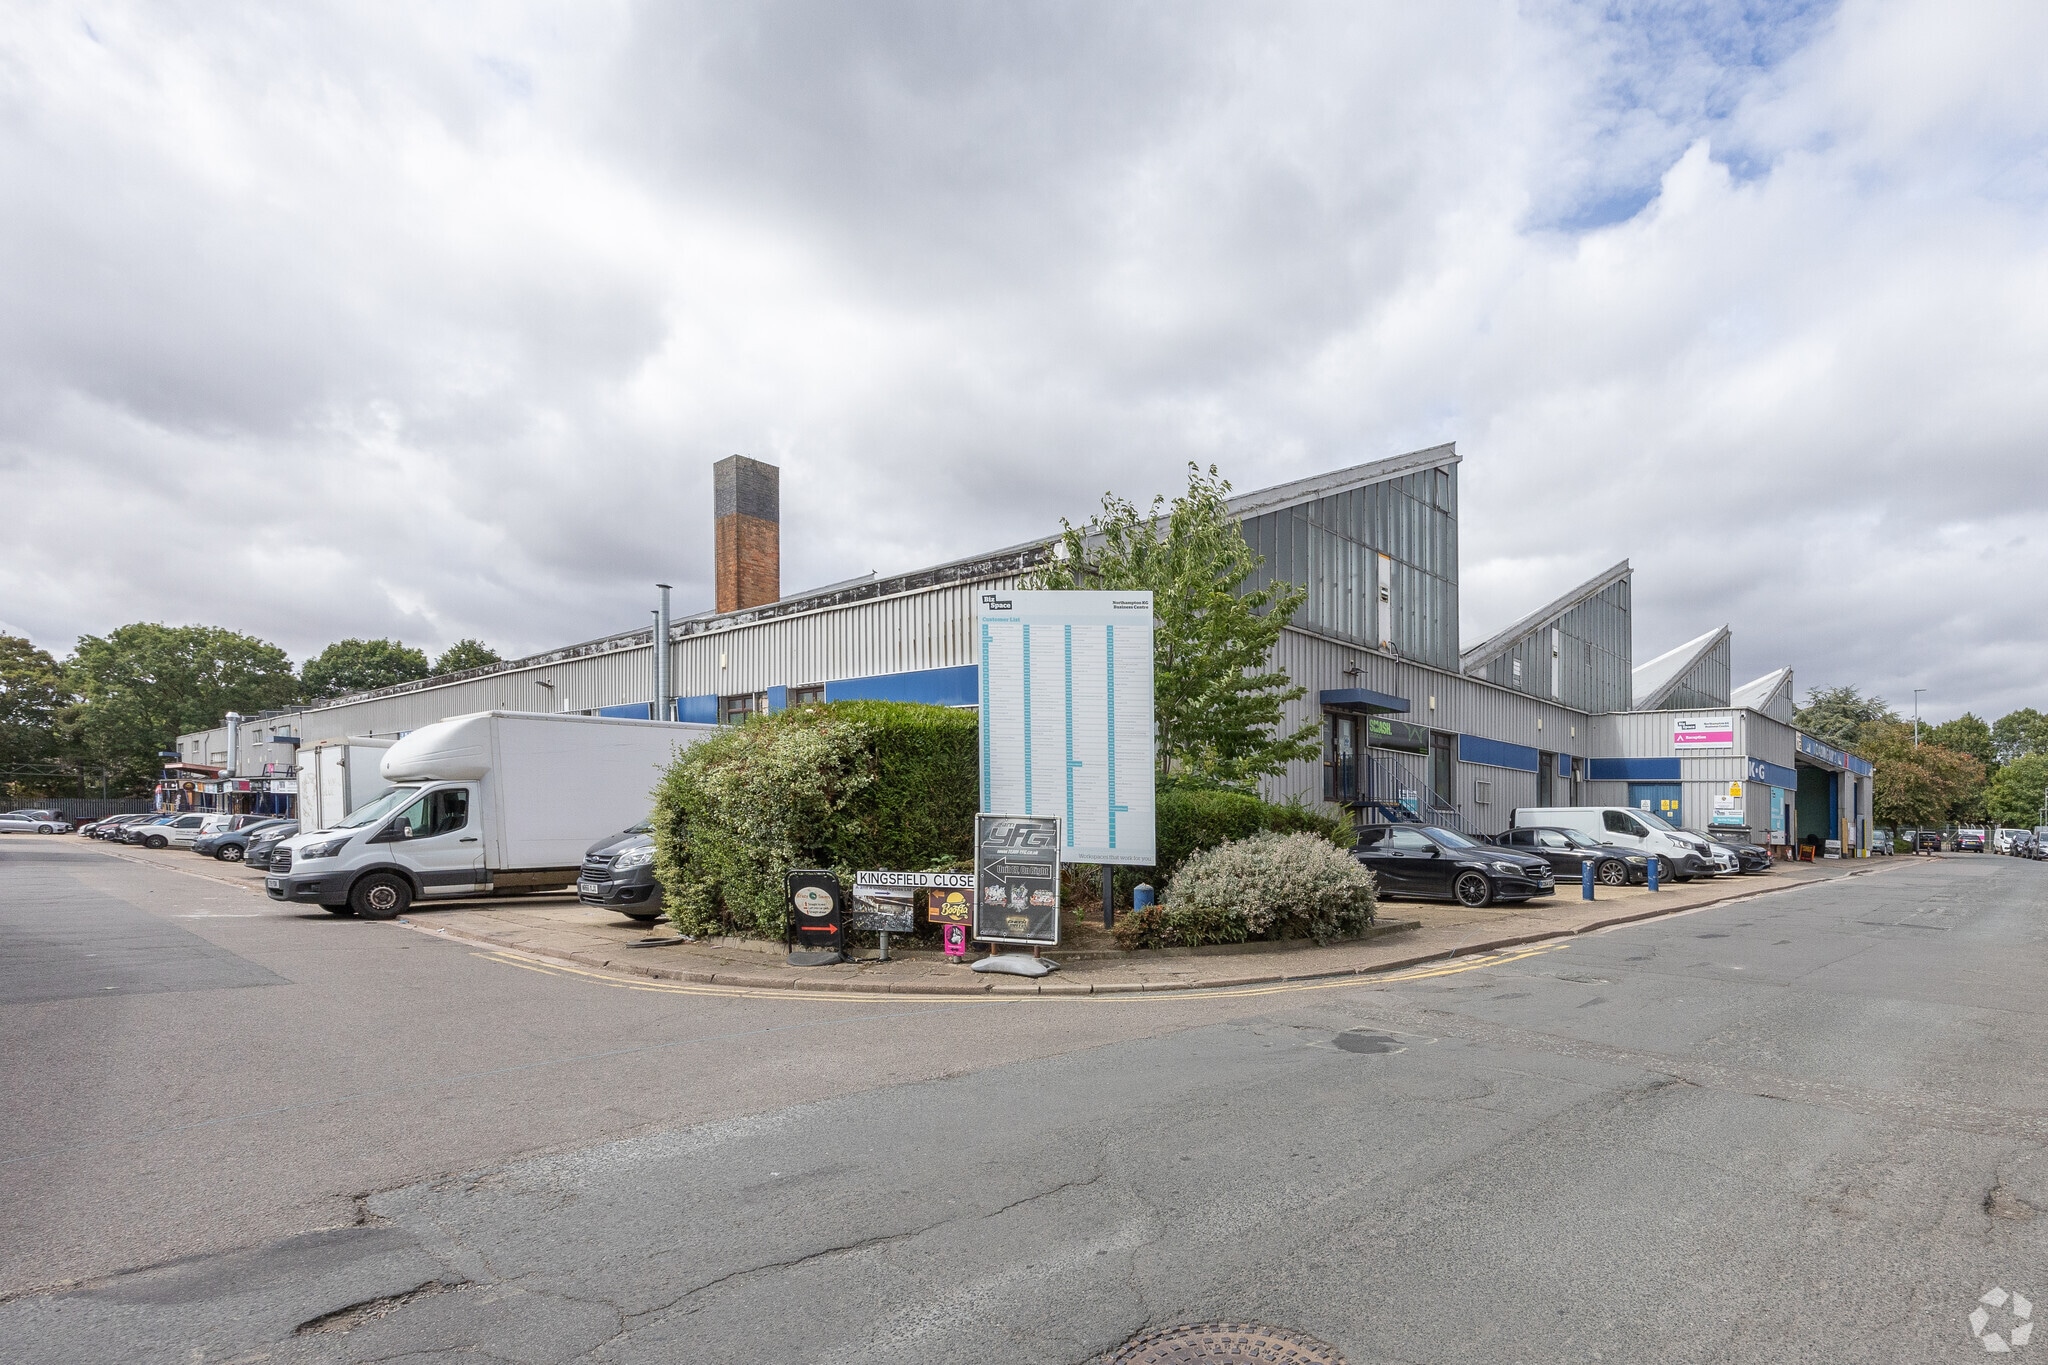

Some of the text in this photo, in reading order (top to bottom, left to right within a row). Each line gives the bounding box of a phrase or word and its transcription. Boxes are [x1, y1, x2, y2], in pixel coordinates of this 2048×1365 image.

[1079, 853, 1108, 861] Workspaces
[860, 872, 974, 887] KINGSFIELD CLOSE
